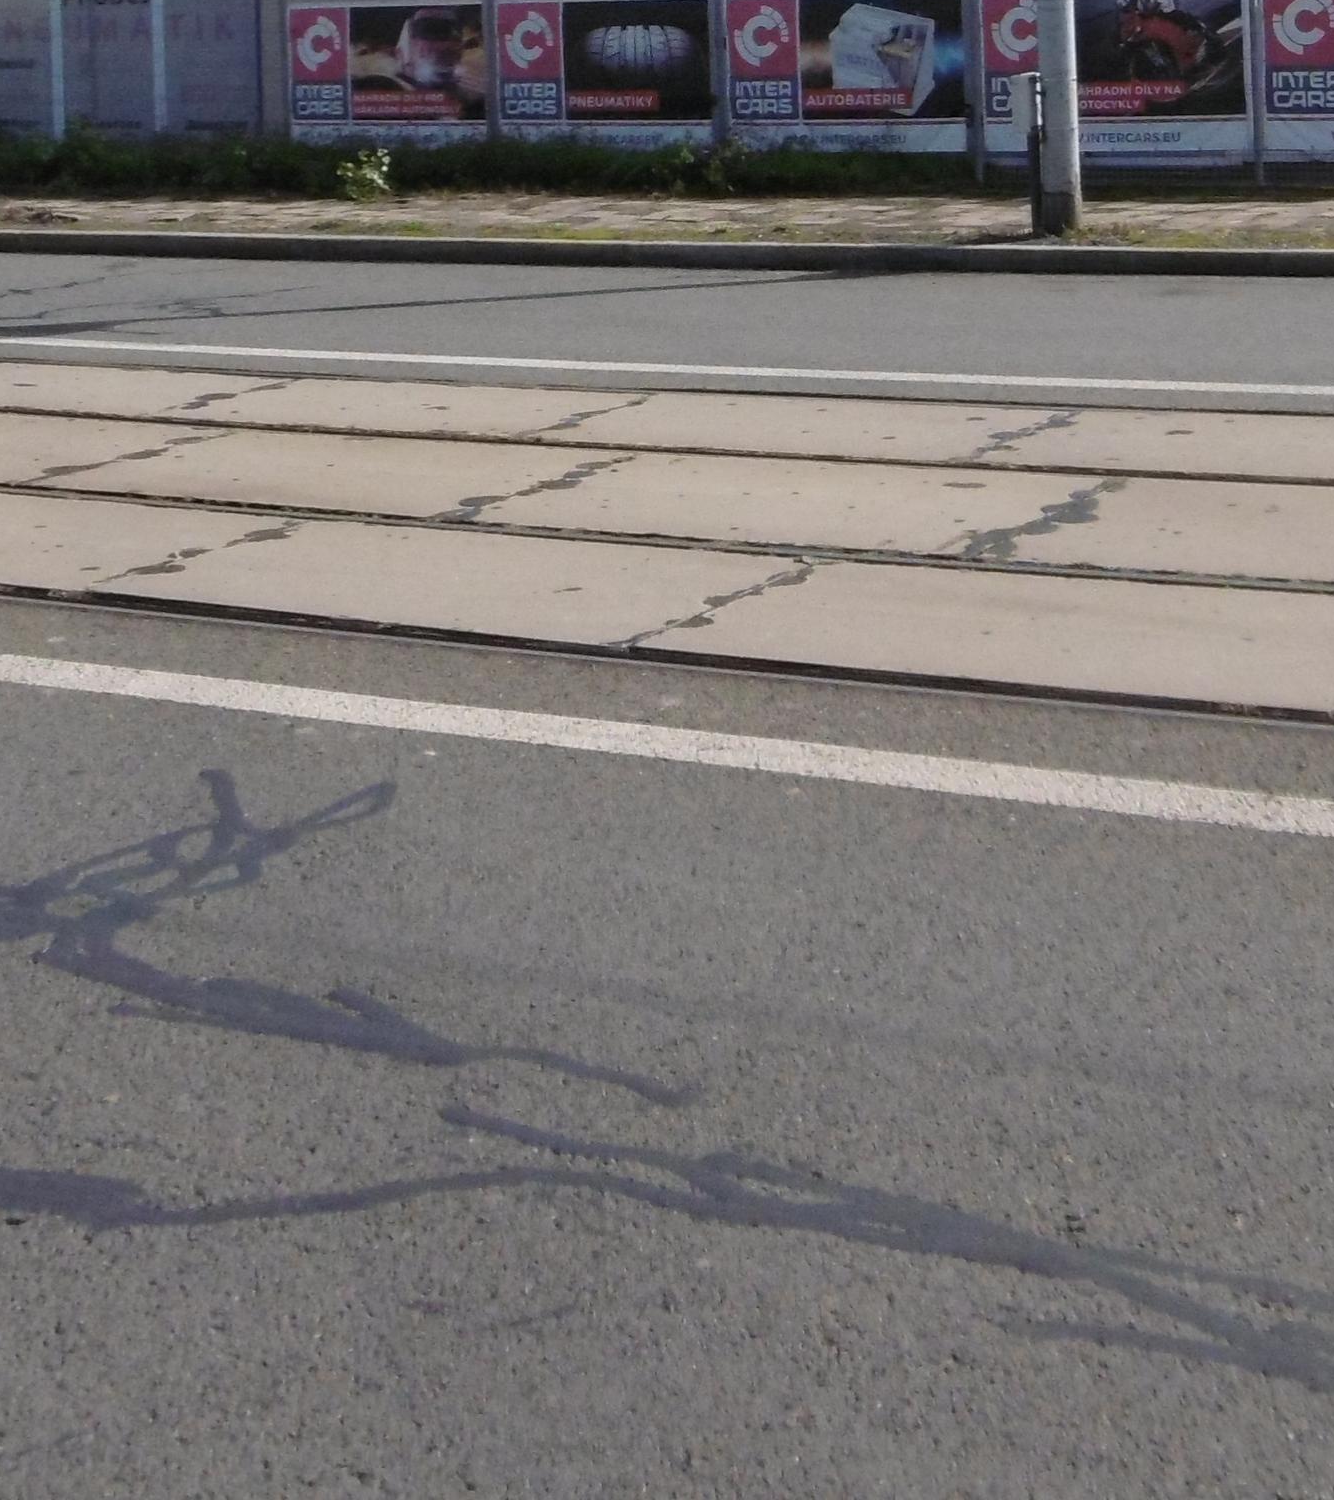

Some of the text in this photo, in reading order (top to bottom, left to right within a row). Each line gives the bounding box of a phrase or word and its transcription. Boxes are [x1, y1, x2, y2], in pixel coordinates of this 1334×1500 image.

[295, 83, 344, 100] INTER
[503, 82, 557, 98] INTER
[735, 80, 792, 98] INTER
[1164, 84, 1183, 96] NA
[296, 100, 344, 116] CARS
[505, 99, 557, 115] CARS
[568, 96, 654, 109] PNEUMATIKY
[735, 98, 793, 114] CARS
[805, 93, 907, 107] AUTOBATERIE
[1078, 99, 1140, 109] OTOCYKLY
